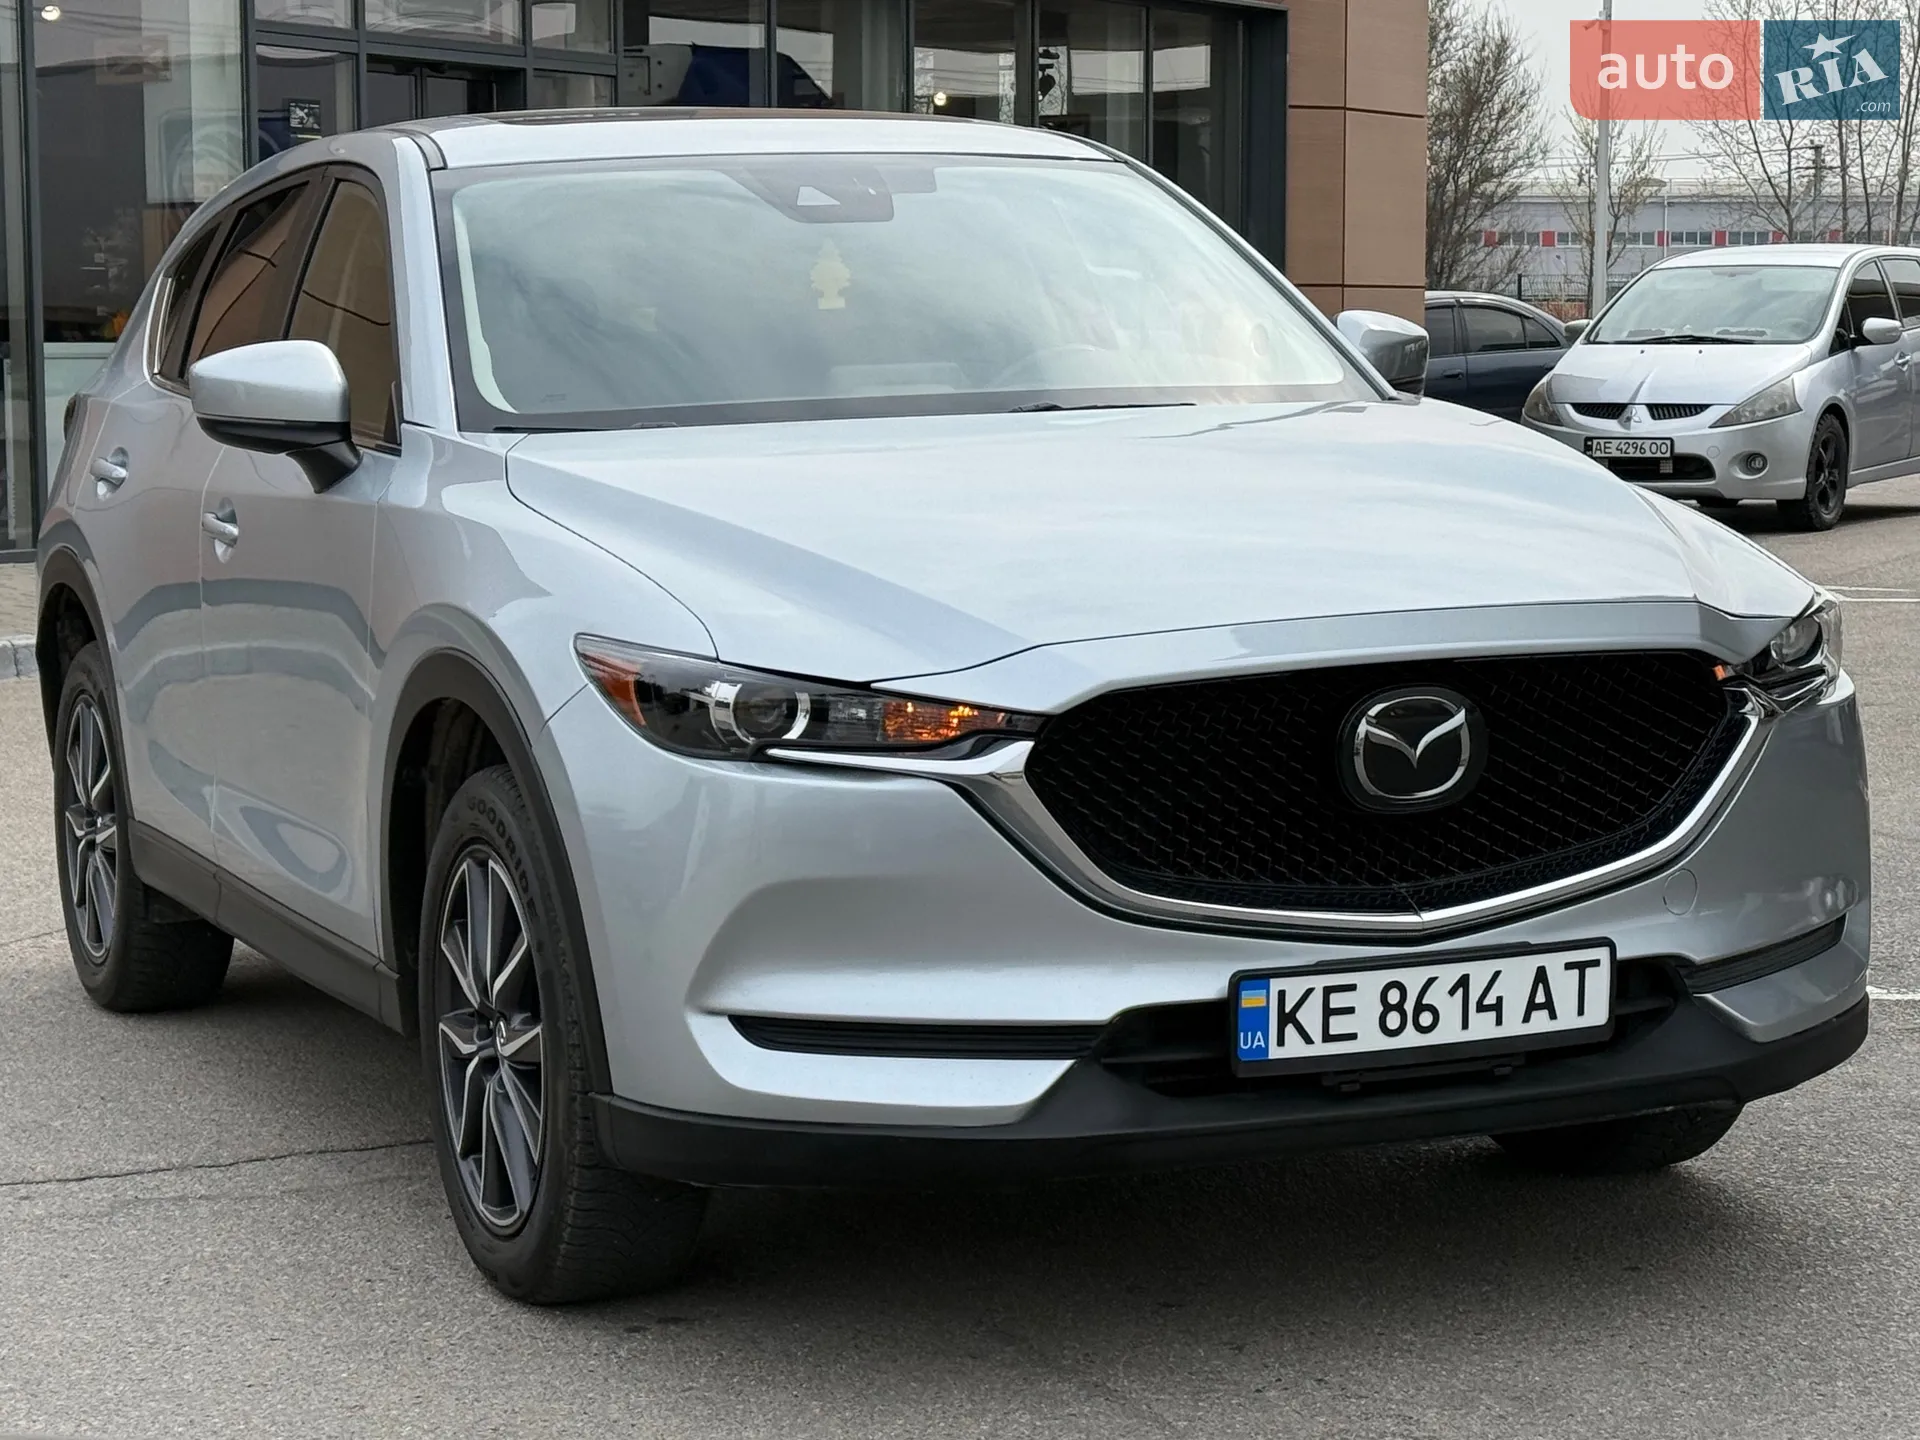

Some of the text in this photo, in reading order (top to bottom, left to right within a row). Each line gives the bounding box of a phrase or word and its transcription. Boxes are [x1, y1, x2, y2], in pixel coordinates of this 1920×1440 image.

[1594, 441, 1613, 454] AE
[1615, 441, 1647, 455] 4296
[1649, 441, 1669, 455] OO
[1276, 958, 1601, 1047] KE 8614 AT
[1240, 1031, 1266, 1050] UA
